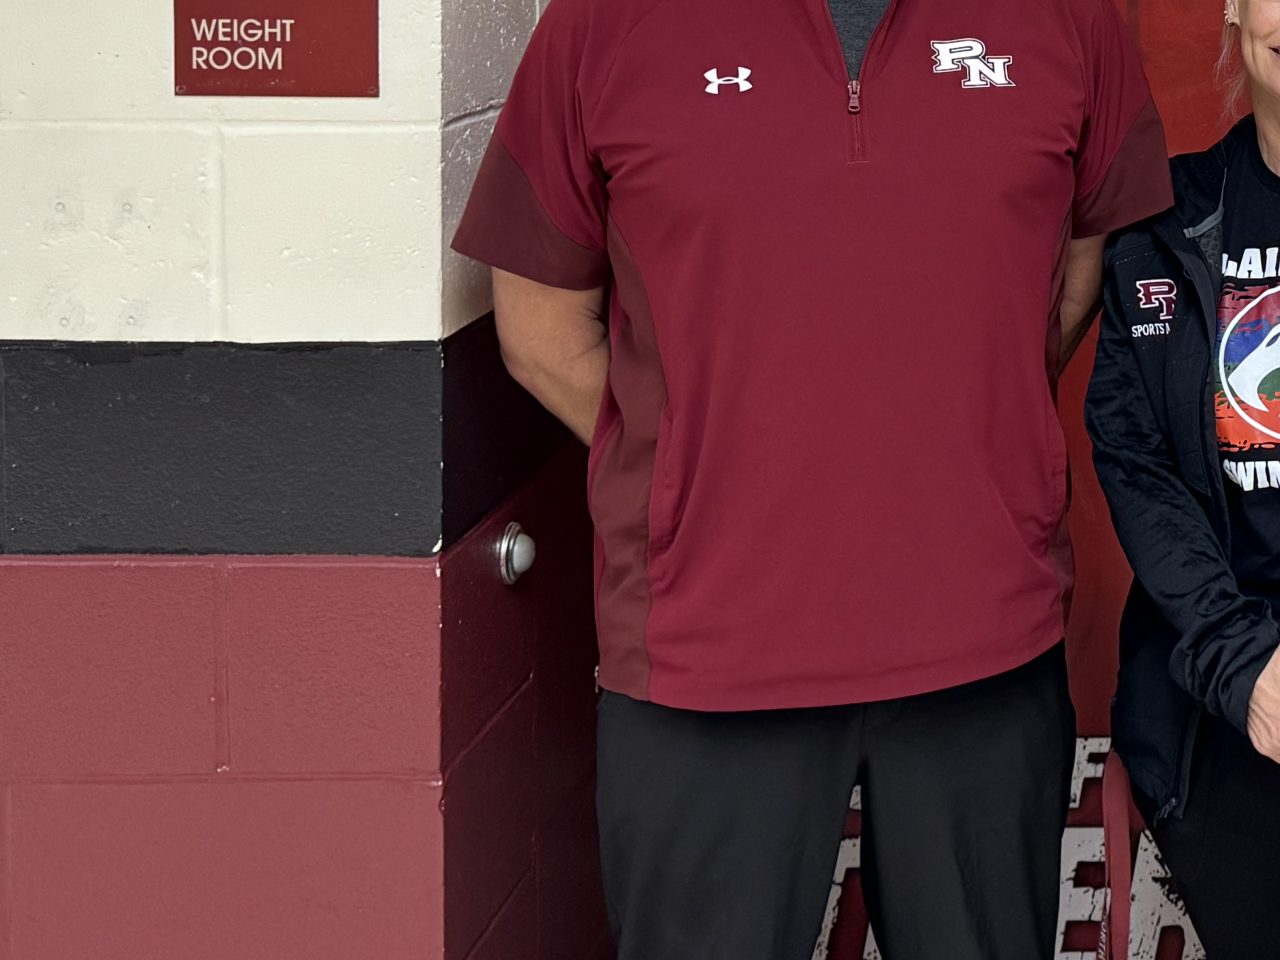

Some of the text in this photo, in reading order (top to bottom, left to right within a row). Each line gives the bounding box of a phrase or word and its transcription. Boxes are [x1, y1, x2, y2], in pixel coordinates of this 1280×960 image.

[191, 18, 295, 43] WEIGHT
[191, 46, 283, 71] ROOM
[1131, 322, 1165, 338] SPORTS
